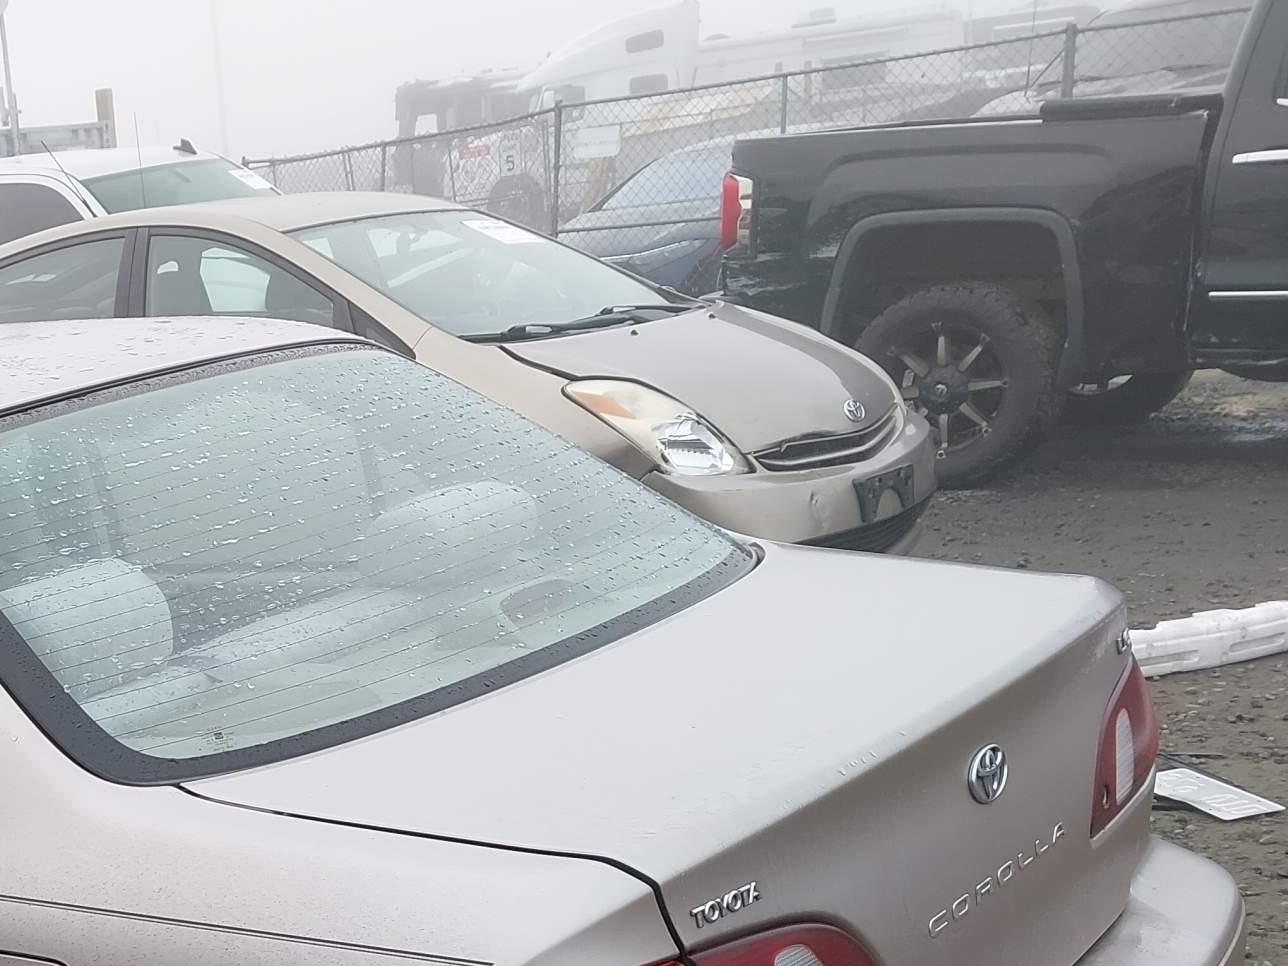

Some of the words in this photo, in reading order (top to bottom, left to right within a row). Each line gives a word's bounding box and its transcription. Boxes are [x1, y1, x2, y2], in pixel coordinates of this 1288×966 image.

[506, 154, 515, 171] 5
[929, 822, 1064, 938] COROLLA
[690, 881, 761, 928] TOYOTA
